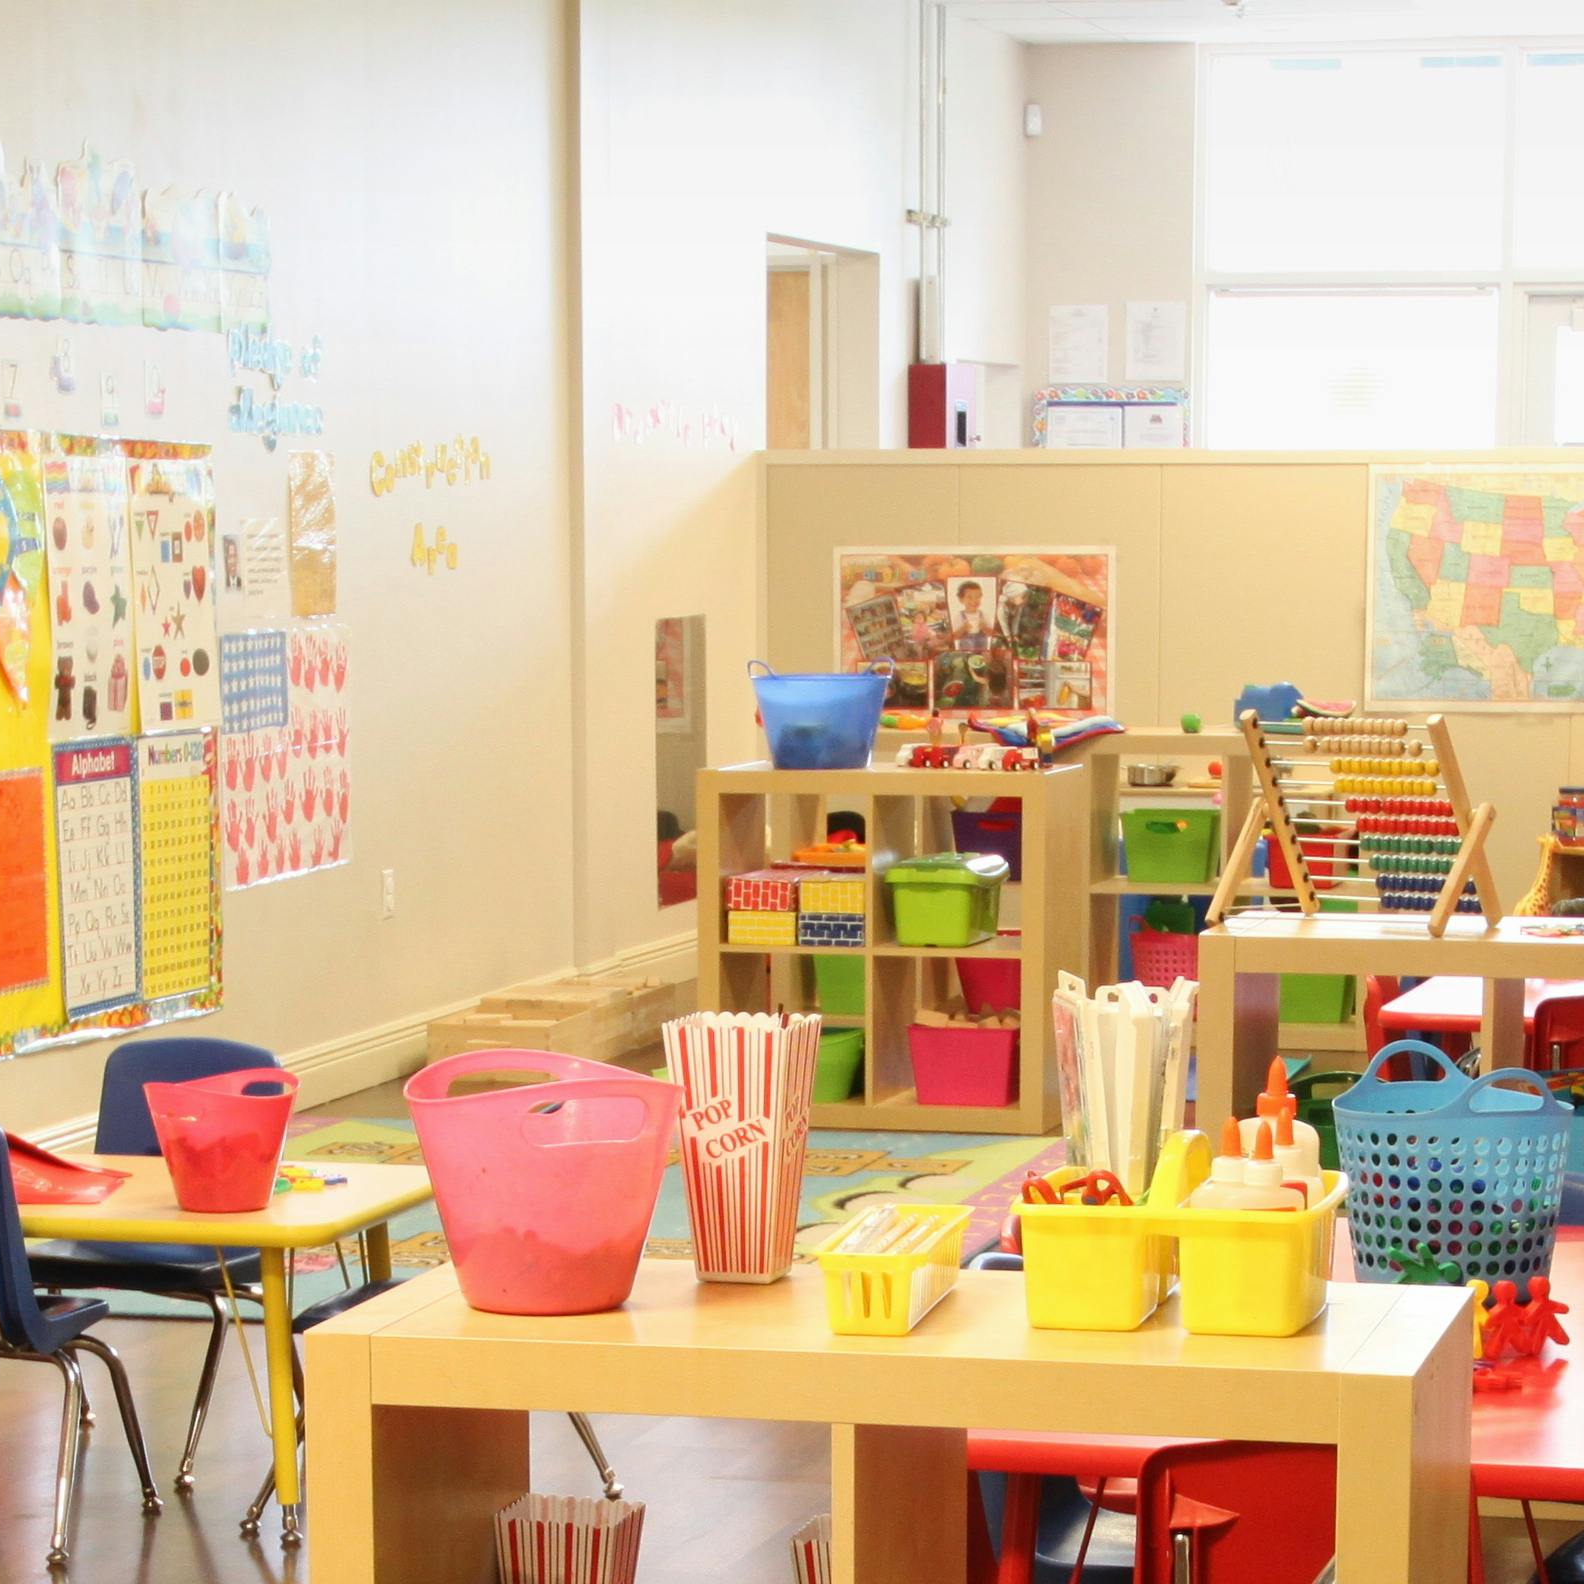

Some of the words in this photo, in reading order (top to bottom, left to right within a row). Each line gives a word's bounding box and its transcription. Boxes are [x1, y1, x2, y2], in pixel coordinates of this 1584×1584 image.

[371, 434, 490, 497] Construction
[411, 523, 457, 576] Area
[71, 751, 115, 778] Alphabet
[148, 743, 182, 766] Numbers
[691, 1098, 733, 1132] POP
[784, 1096, 800, 1129] POP
[705, 1119, 767, 1159] CORN
